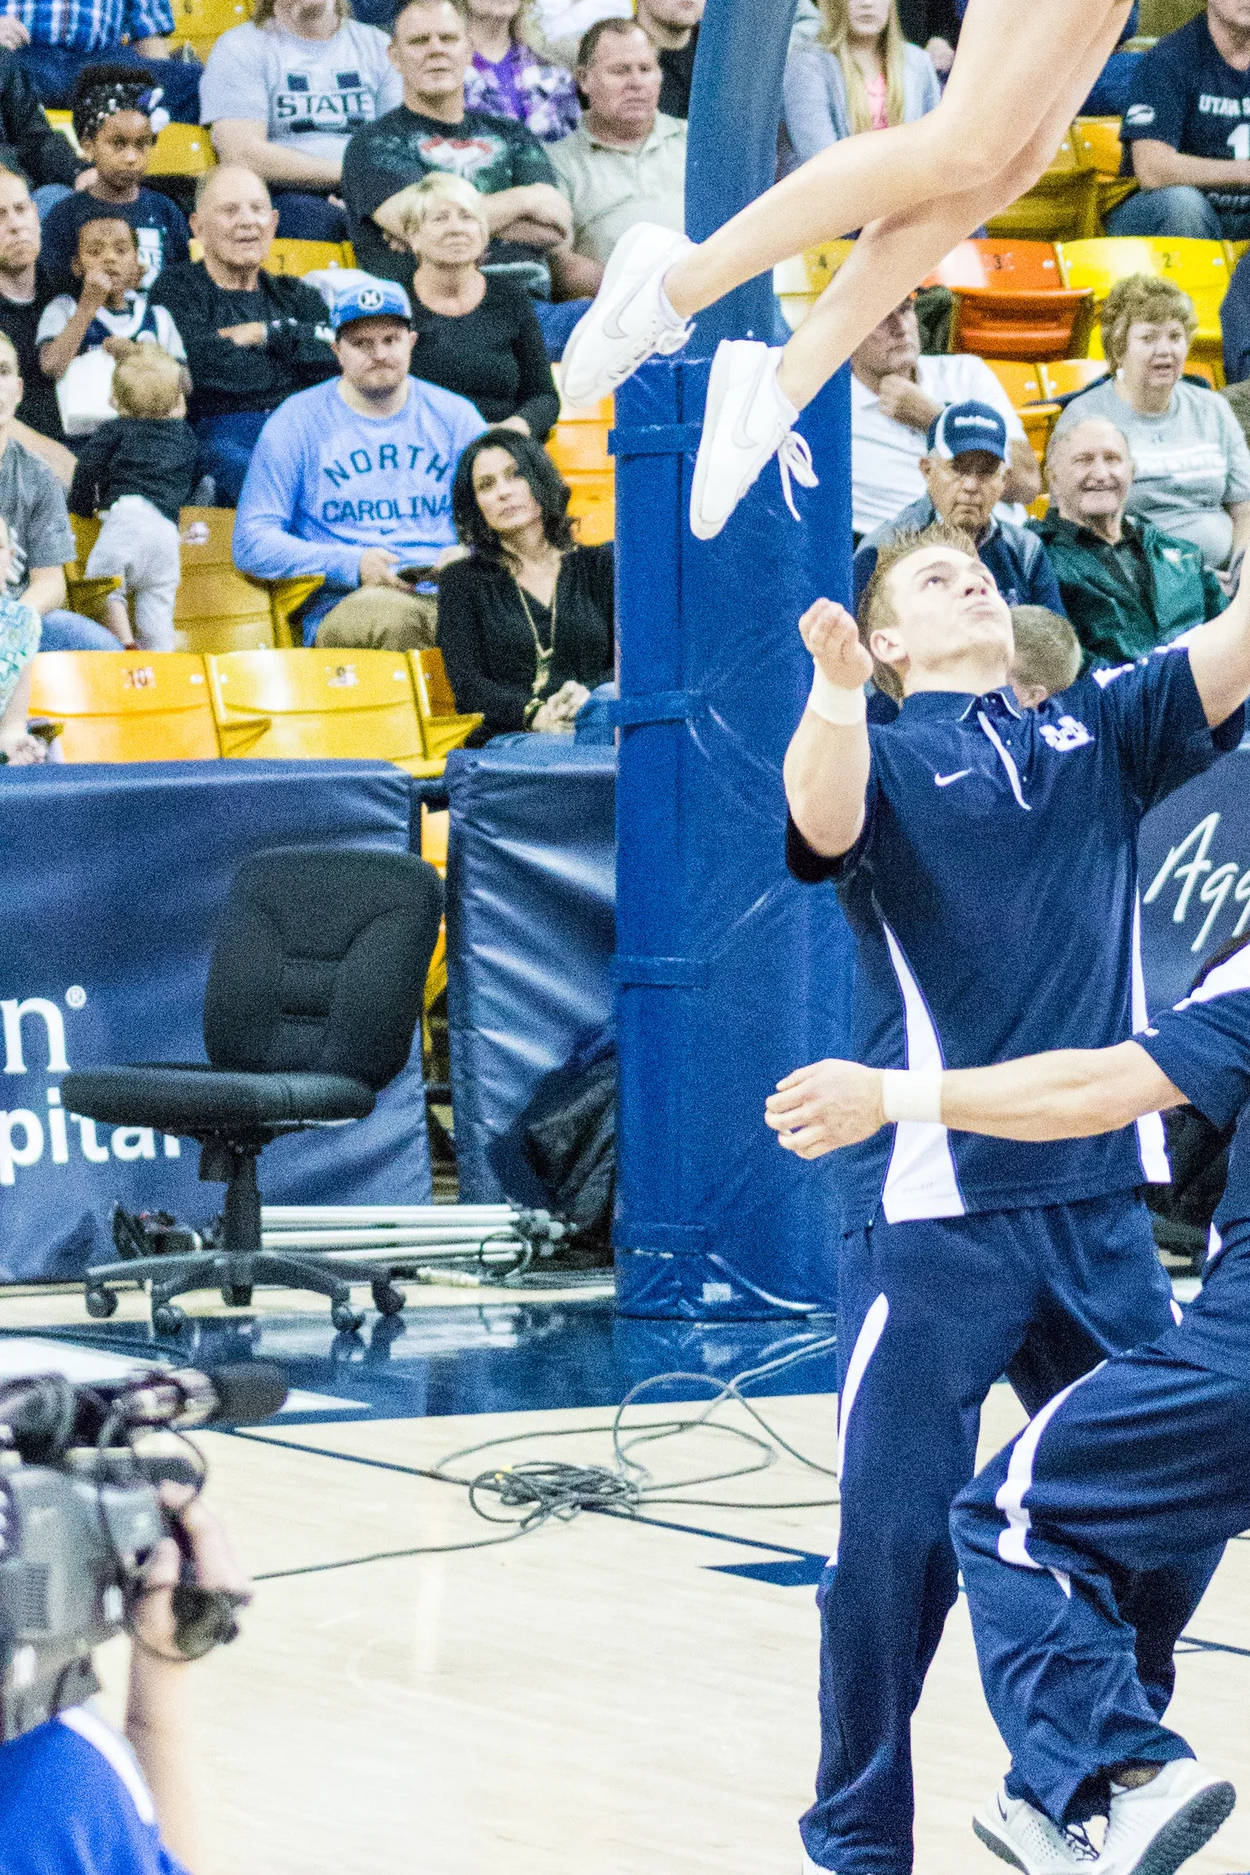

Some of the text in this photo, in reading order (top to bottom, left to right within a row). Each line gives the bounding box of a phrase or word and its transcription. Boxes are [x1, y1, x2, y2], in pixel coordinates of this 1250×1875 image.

[276, 91, 374, 119] STATE
[1199, 93, 1241, 118] UTAH
[322, 443, 450, 489] NORTH
[321, 494, 454, 523] CAROLINA
